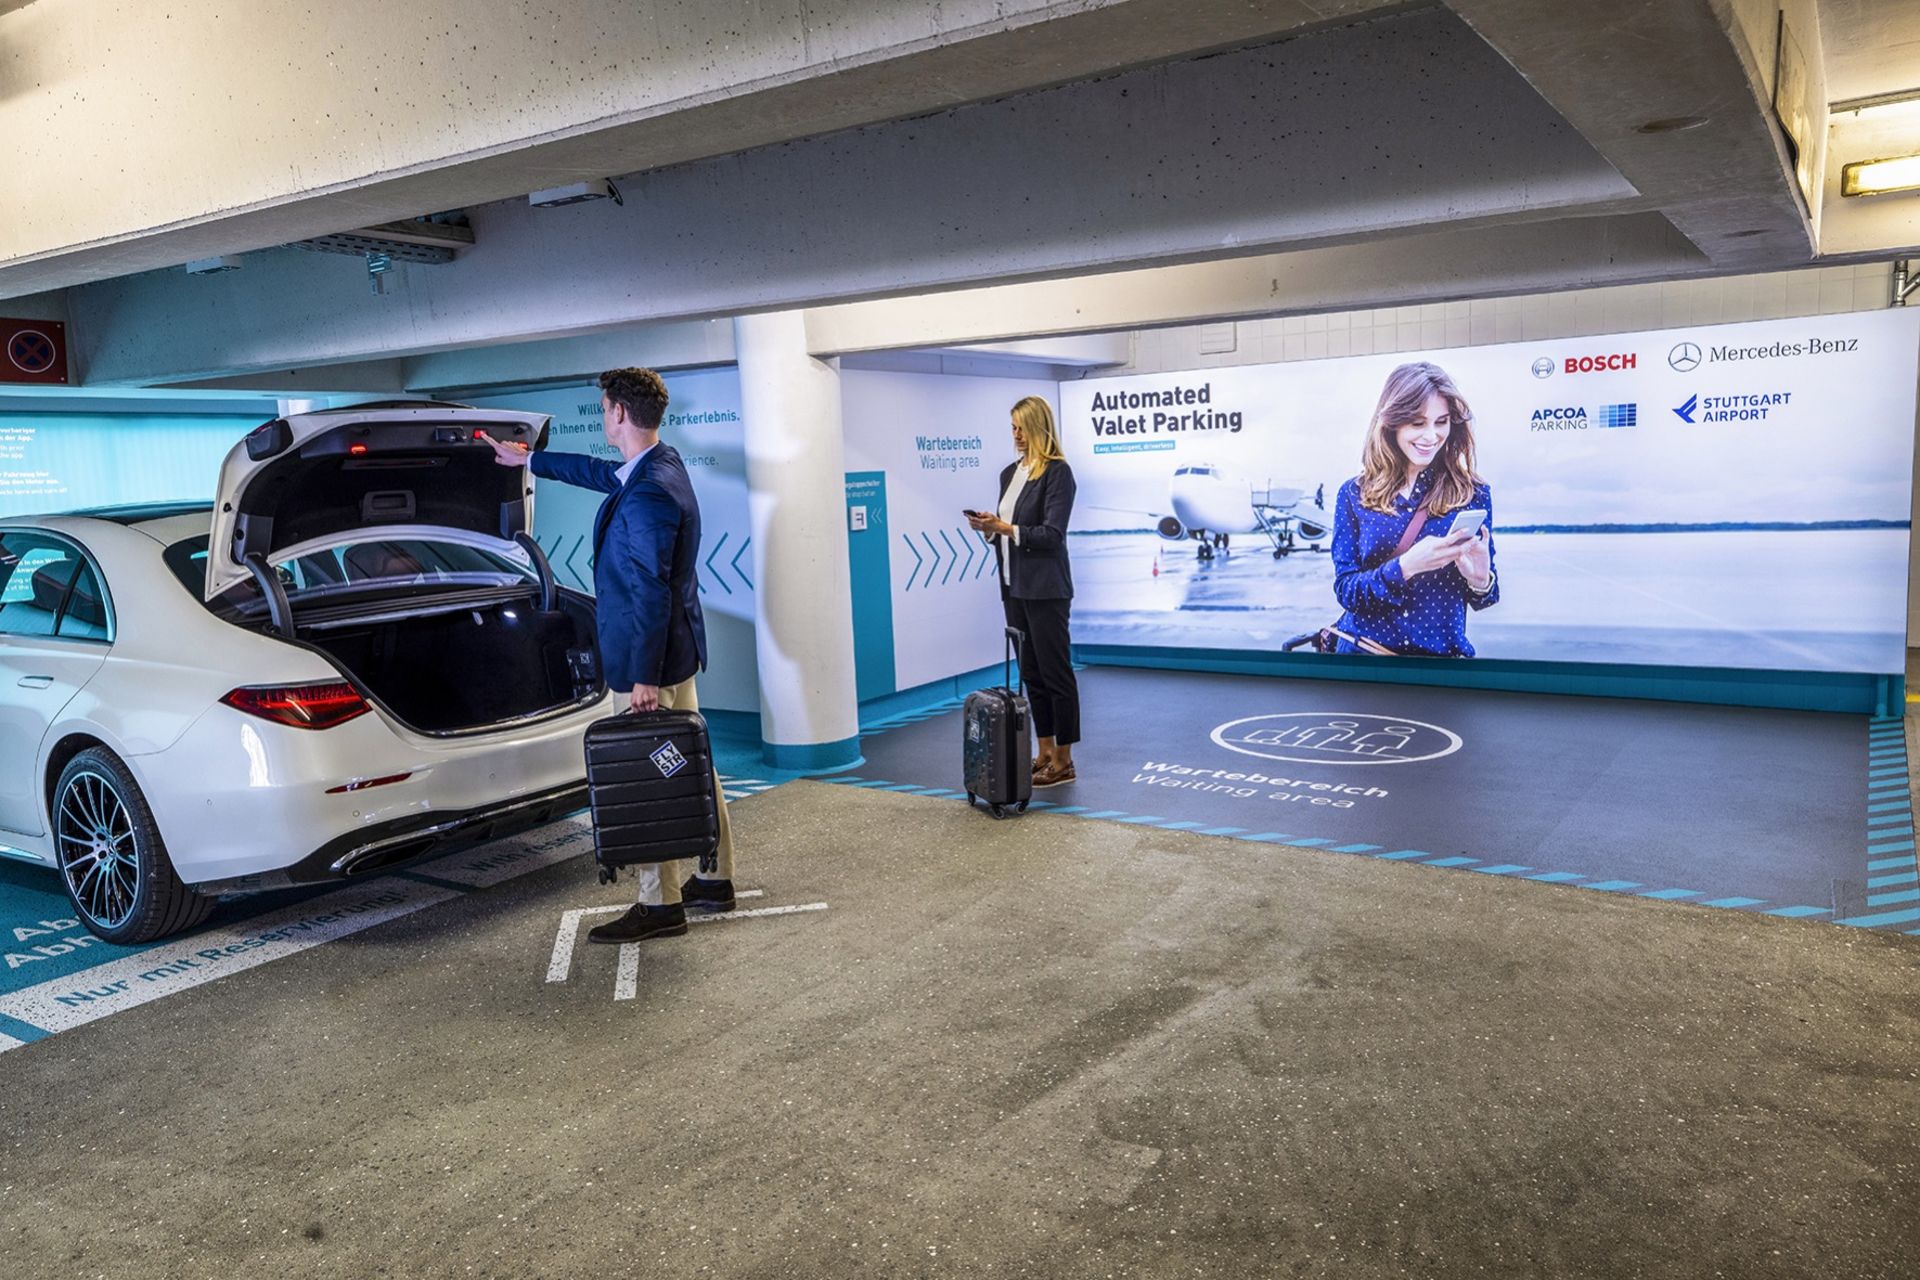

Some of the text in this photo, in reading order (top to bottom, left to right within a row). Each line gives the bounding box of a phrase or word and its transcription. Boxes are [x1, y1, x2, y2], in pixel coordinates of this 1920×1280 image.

[1709, 338, 1859, 363] Mercedes-Benz
[1565, 353, 1637, 374] BOSCH
[1091, 382, 1211, 412] Automated
[1703, 392, 1792, 409] STUTTGART
[577, 404, 605, 417] Willk
[1531, 406, 1587, 421] APCOA
[1703, 408, 1769, 423] AIRPORT
[559, 423, 586, 435] Ihnen
[668, 410, 741, 426] Parkerlebnis.
[1091, 409, 1243, 436] Valet Parking
[1530, 418, 1588, 432] PARKING
[589, 443, 621, 455] Welco
[915, 436, 982, 451] Wartebereich
[684, 455, 720, 467] rience.
[920, 454, 980, 472] Waiting area
[653, 745, 676, 767] FLY
[660, 752, 683, 773] STR
[1141, 761, 1389, 799] Wartebereich
[1131, 773, 1356, 809] Waiting area
[12, 915, 81, 942] Ab
[3, 934, 104, 969] Abh
[54, 979, 130, 1007] Nur
[138, 958, 202, 982] mit
